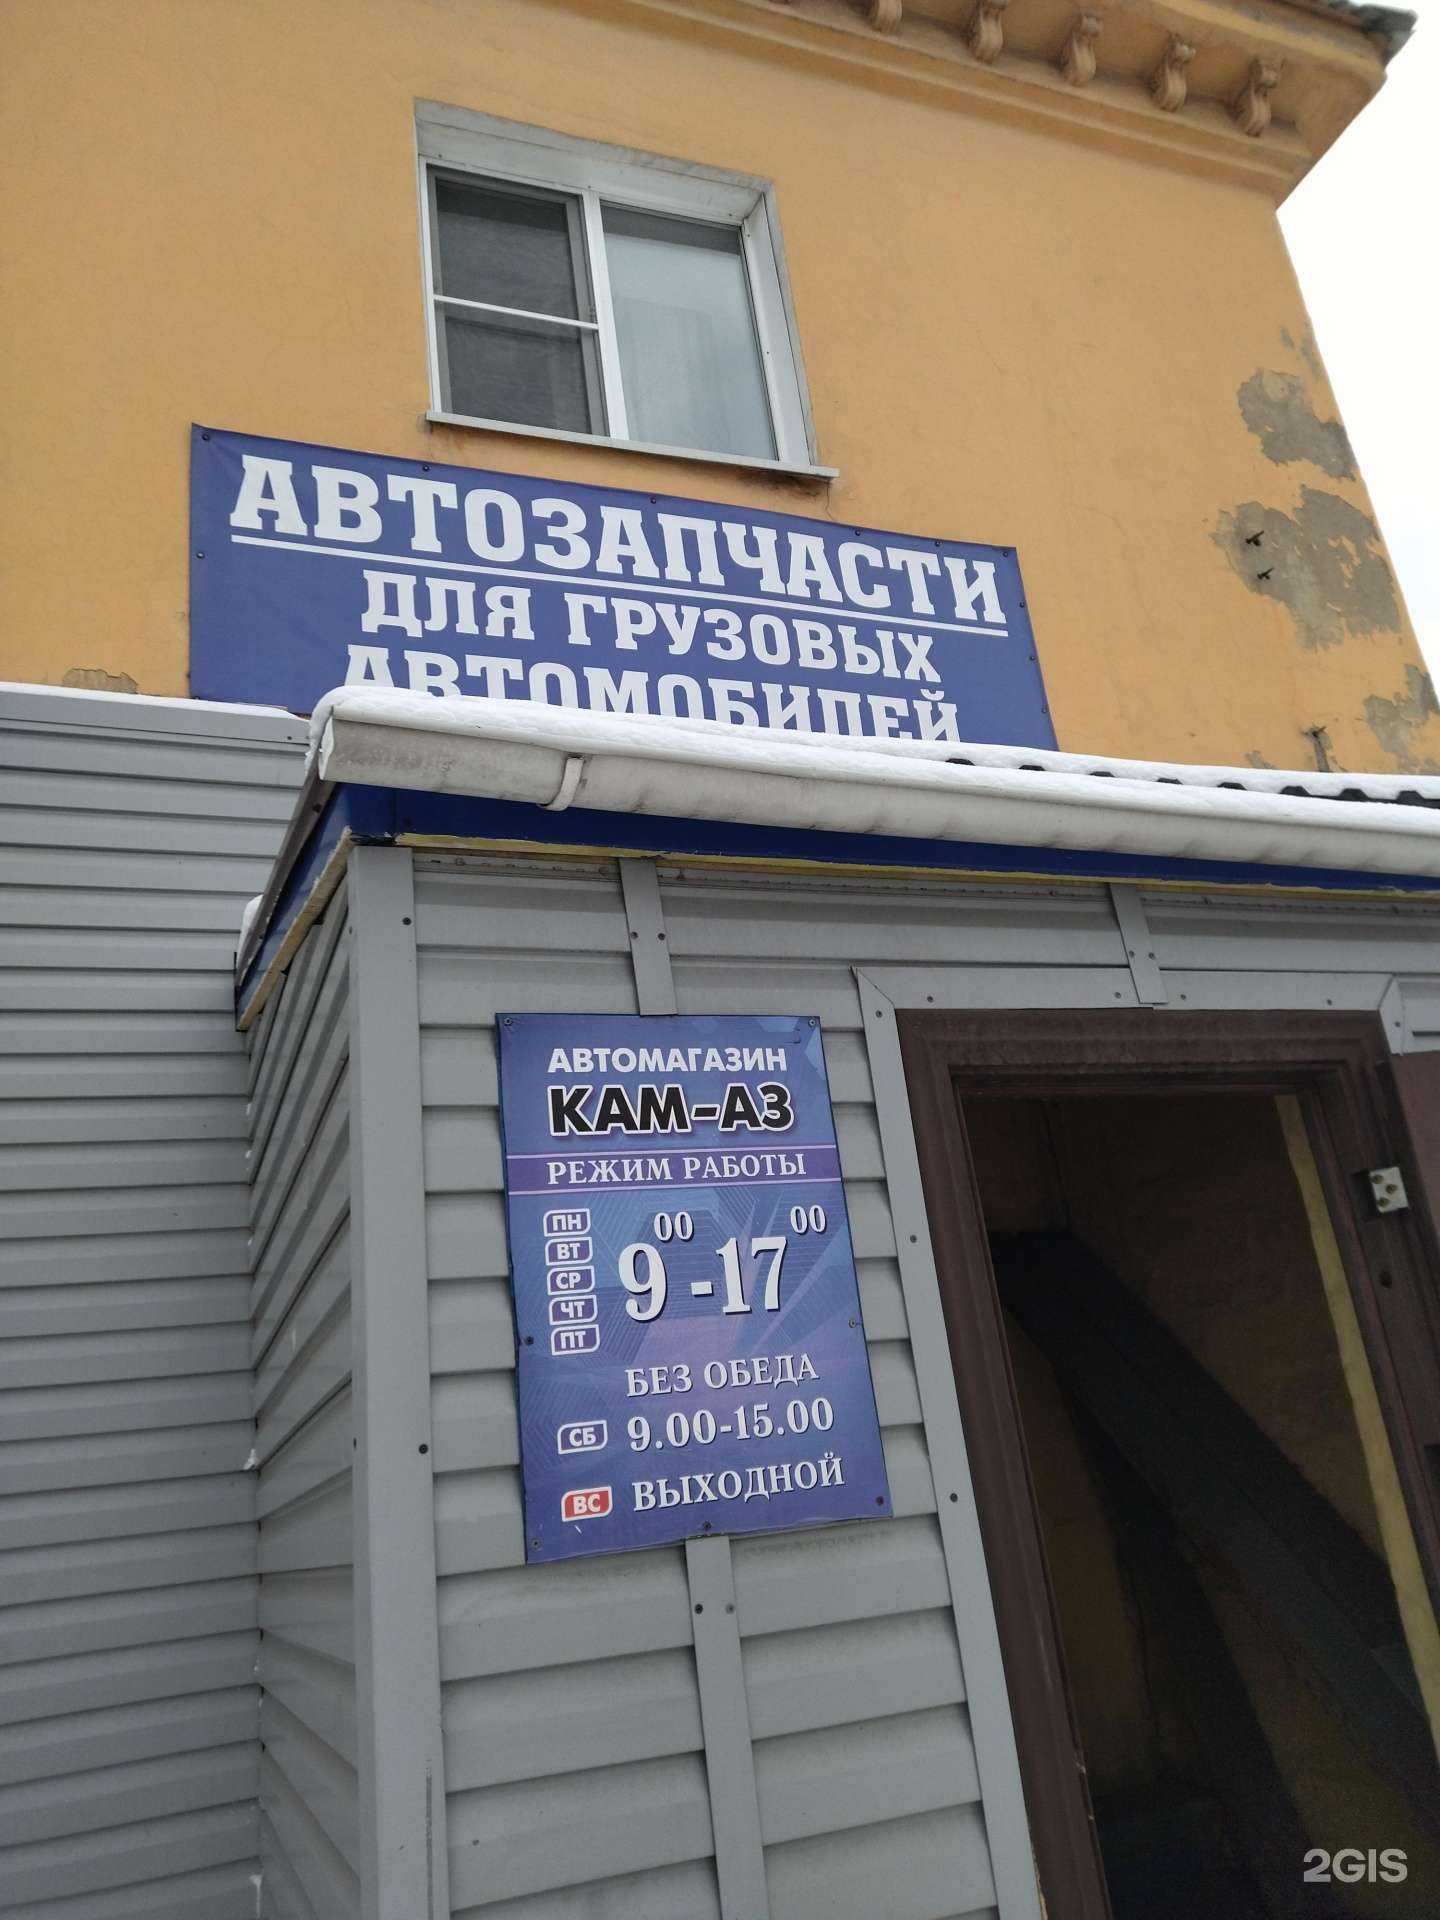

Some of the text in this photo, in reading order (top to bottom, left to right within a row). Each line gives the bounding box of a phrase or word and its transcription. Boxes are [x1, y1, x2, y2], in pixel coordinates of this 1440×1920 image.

[229, 454, 1007, 625] АВТОЗАПЧАСТИ
[361, 569, 942, 683] ДЛЯ ГРУЗОВЫХ
[547, 1047, 788, 1074] АВТОМАГАЗИН
[547, 1081, 796, 1137] КАМ-АЗ
[546, 1153, 807, 1185] РЕЖИМ РАБОТЫ
[552, 1214, 582, 1231] ПН
[556, 1242, 581, 1260] ВТ
[556, 1272, 581, 1290] СР
[560, 1300, 586, 1318] ЧТ
[560, 1330, 587, 1349] ПТ
[625, 1353, 820, 1398] БЕЗ ОБЕДА
[569, 1397, 835, 1452] СБ 9.00-15.00
[572, 1452, 845, 1515] ВС ВЫХОДНОЙ
